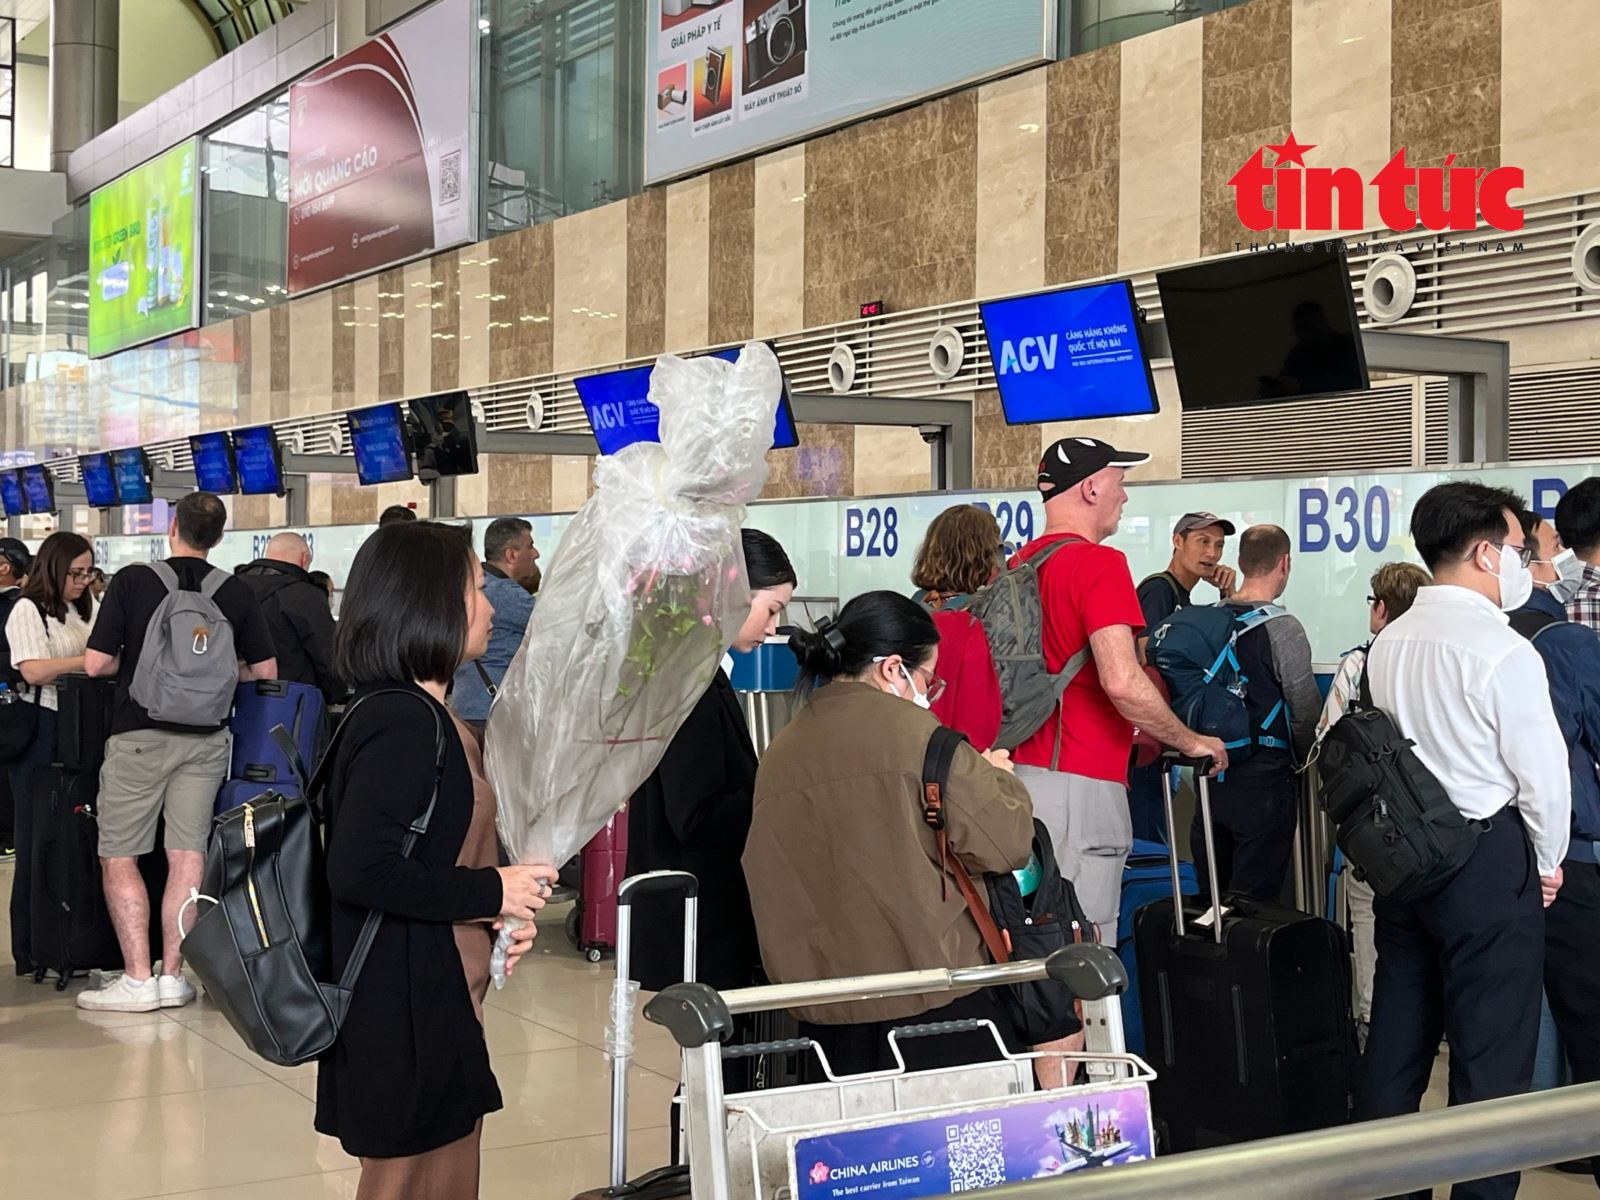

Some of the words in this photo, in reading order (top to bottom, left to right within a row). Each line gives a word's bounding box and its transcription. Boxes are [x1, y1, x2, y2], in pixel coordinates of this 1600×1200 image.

[671, 33, 686, 49] GIẢI
[687, 24, 706, 44] PHÁP
[708, 23, 713, 35] Y
[713, 14, 722, 32] TẾ
[314, 157, 351, 192] QUẢNG
[353, 144, 378, 173] CÁO
[1068, 340, 1086, 354] QUỐC
[1087, 338, 1096, 350] TẾ
[1103, 323, 1128, 335] KHÔNG
[1000, 334, 1058, 375] ACV
[592, 401, 625, 430] ACV
[846, 506, 898, 557] B28
[972, 500, 1034, 556] 29
[1299, 485, 1390, 553] B30
[830, 1165, 868, 1181] CHINA
[869, 1155, 919, 1174] AIRLINES
[832, 1188, 843, 1197] The
[845, 1184, 858, 1194] best
[860, 1182, 881, 1193] carrier
[883, 1179, 897, 1188] from
[899, 1175, 920, 1185] Taiwan
